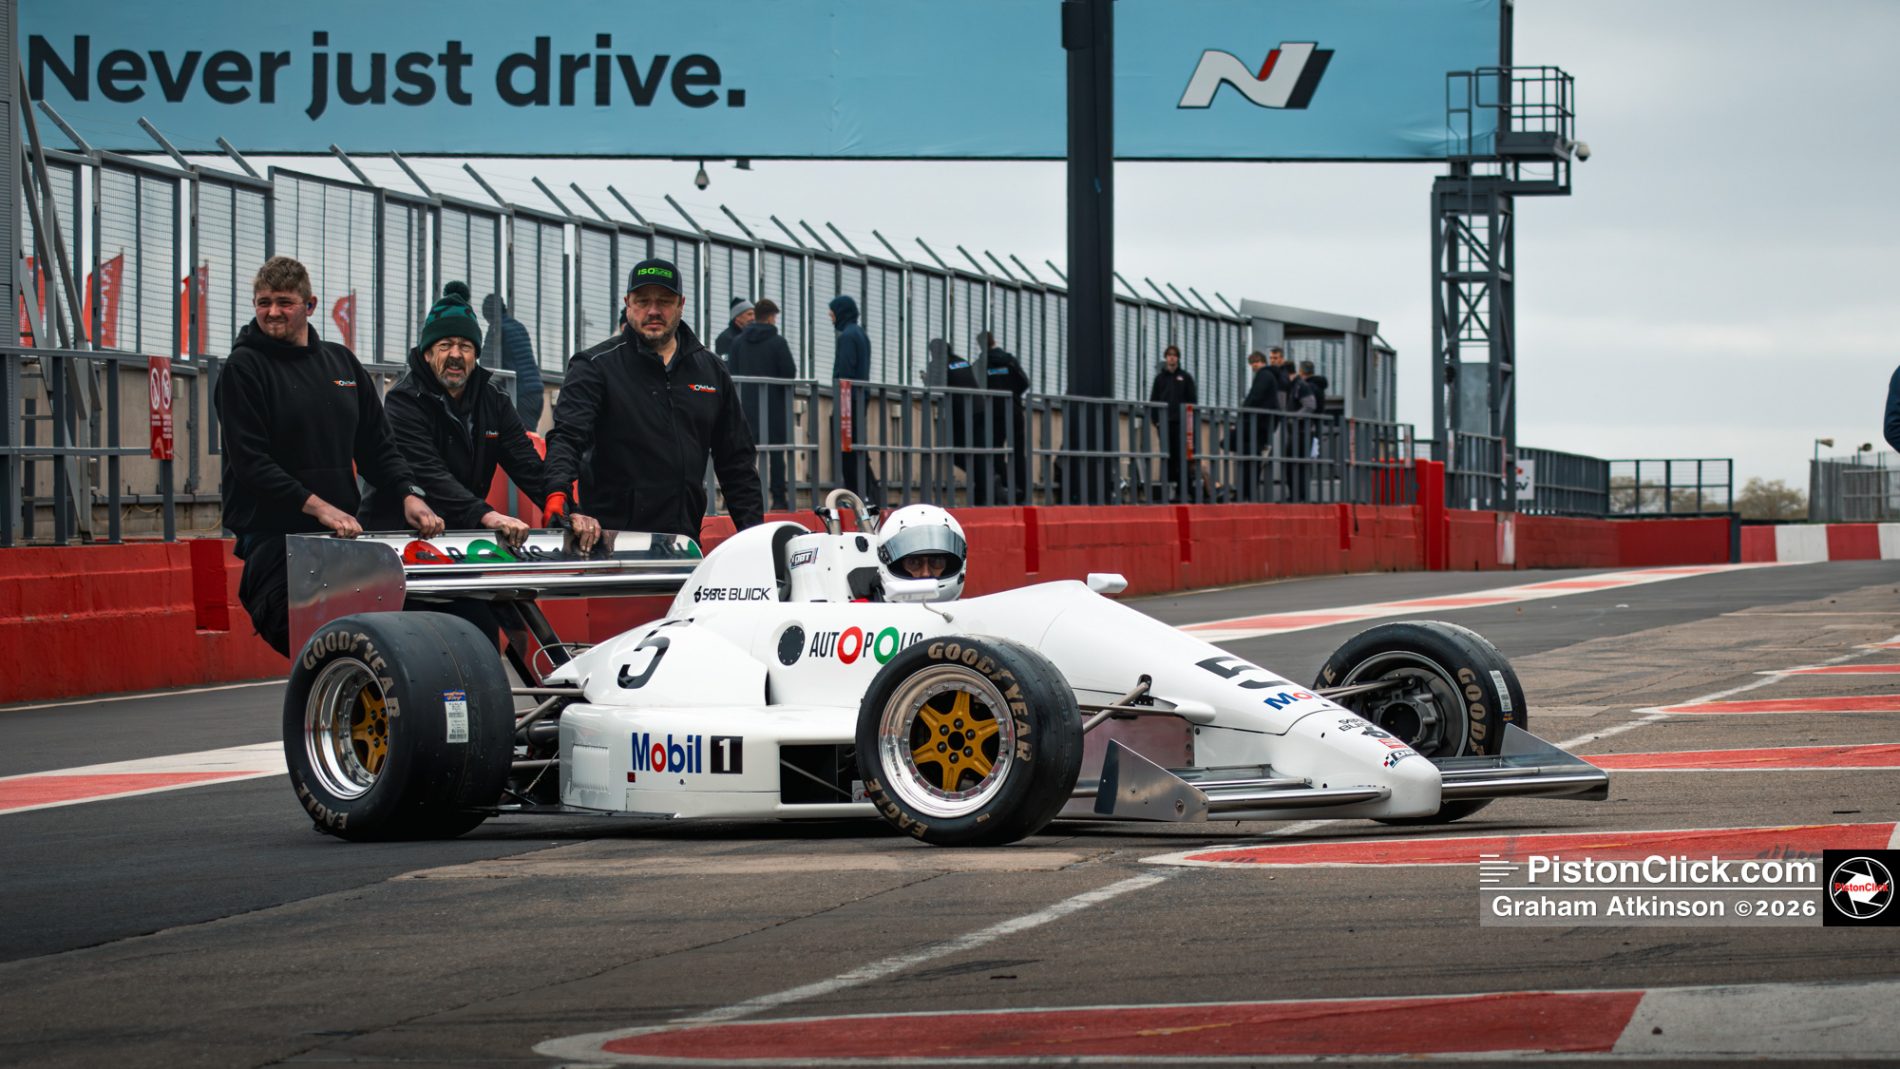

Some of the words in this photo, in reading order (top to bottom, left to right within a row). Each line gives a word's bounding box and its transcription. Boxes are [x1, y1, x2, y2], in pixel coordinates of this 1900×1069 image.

[28, 34, 291, 104] Never
[305, 31, 473, 120] just
[496, 33, 745, 107] drive.
[728, 587, 771, 601] BUICK
[303, 631, 401, 717] GOODYEAR
[1195, 656, 1293, 690] 5
[928, 641, 1033, 762] GOODYEAR
[631, 732, 702, 774] Mobil
[298, 781, 349, 830] EAGLE
[865, 777, 929, 838] EAGLE
